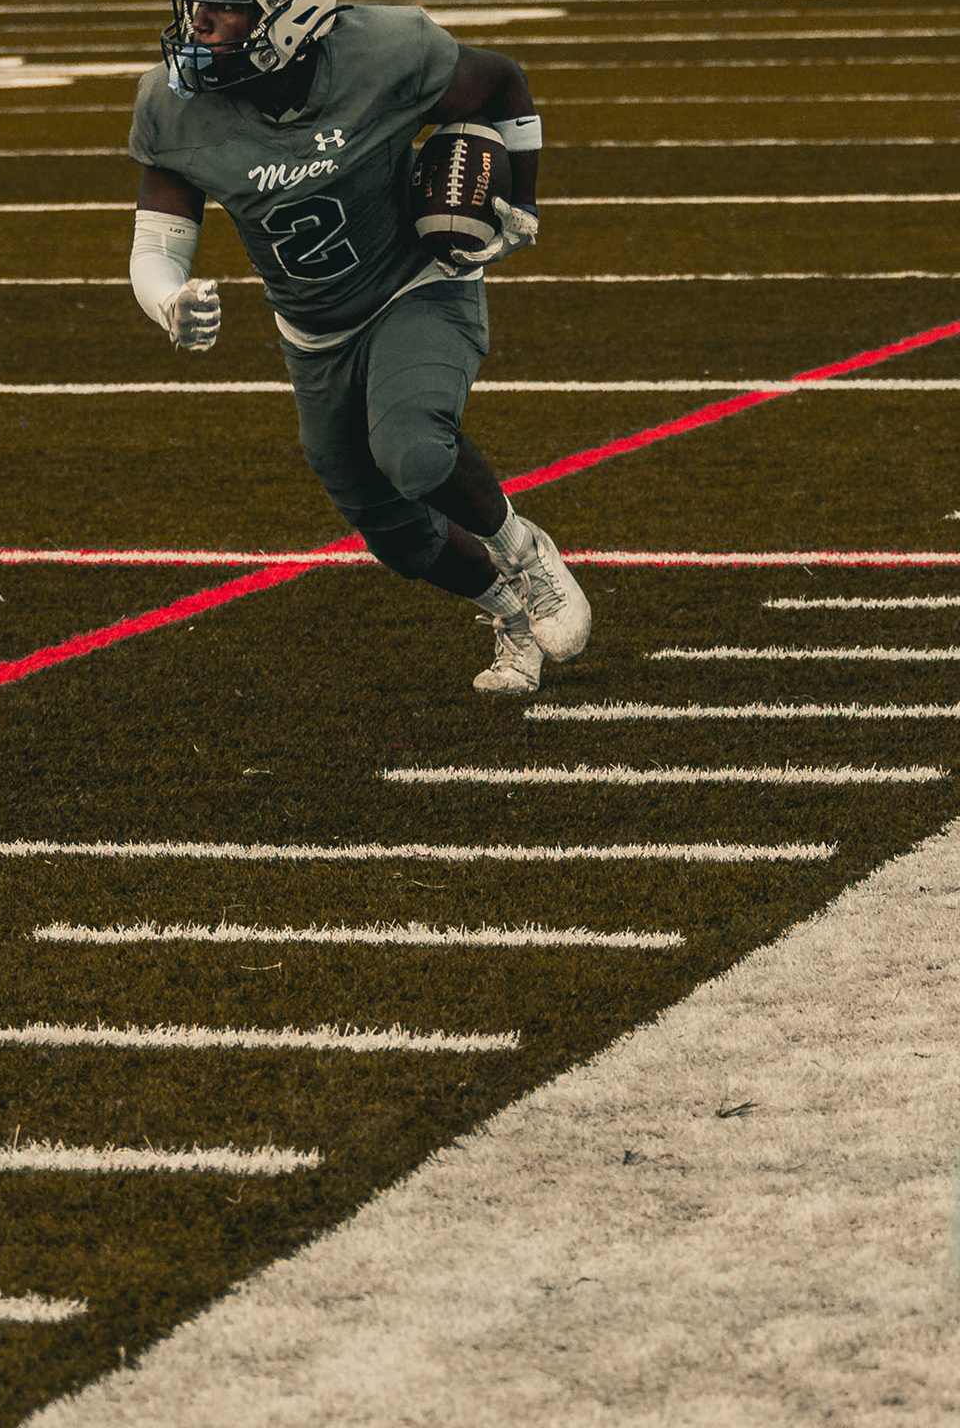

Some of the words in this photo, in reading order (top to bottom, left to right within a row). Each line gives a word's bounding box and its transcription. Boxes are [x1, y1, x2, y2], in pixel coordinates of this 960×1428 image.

[248, 159, 339, 192] Myer
[471, 152, 492, 207] Wilson
[260, 195, 360, 281] 2
